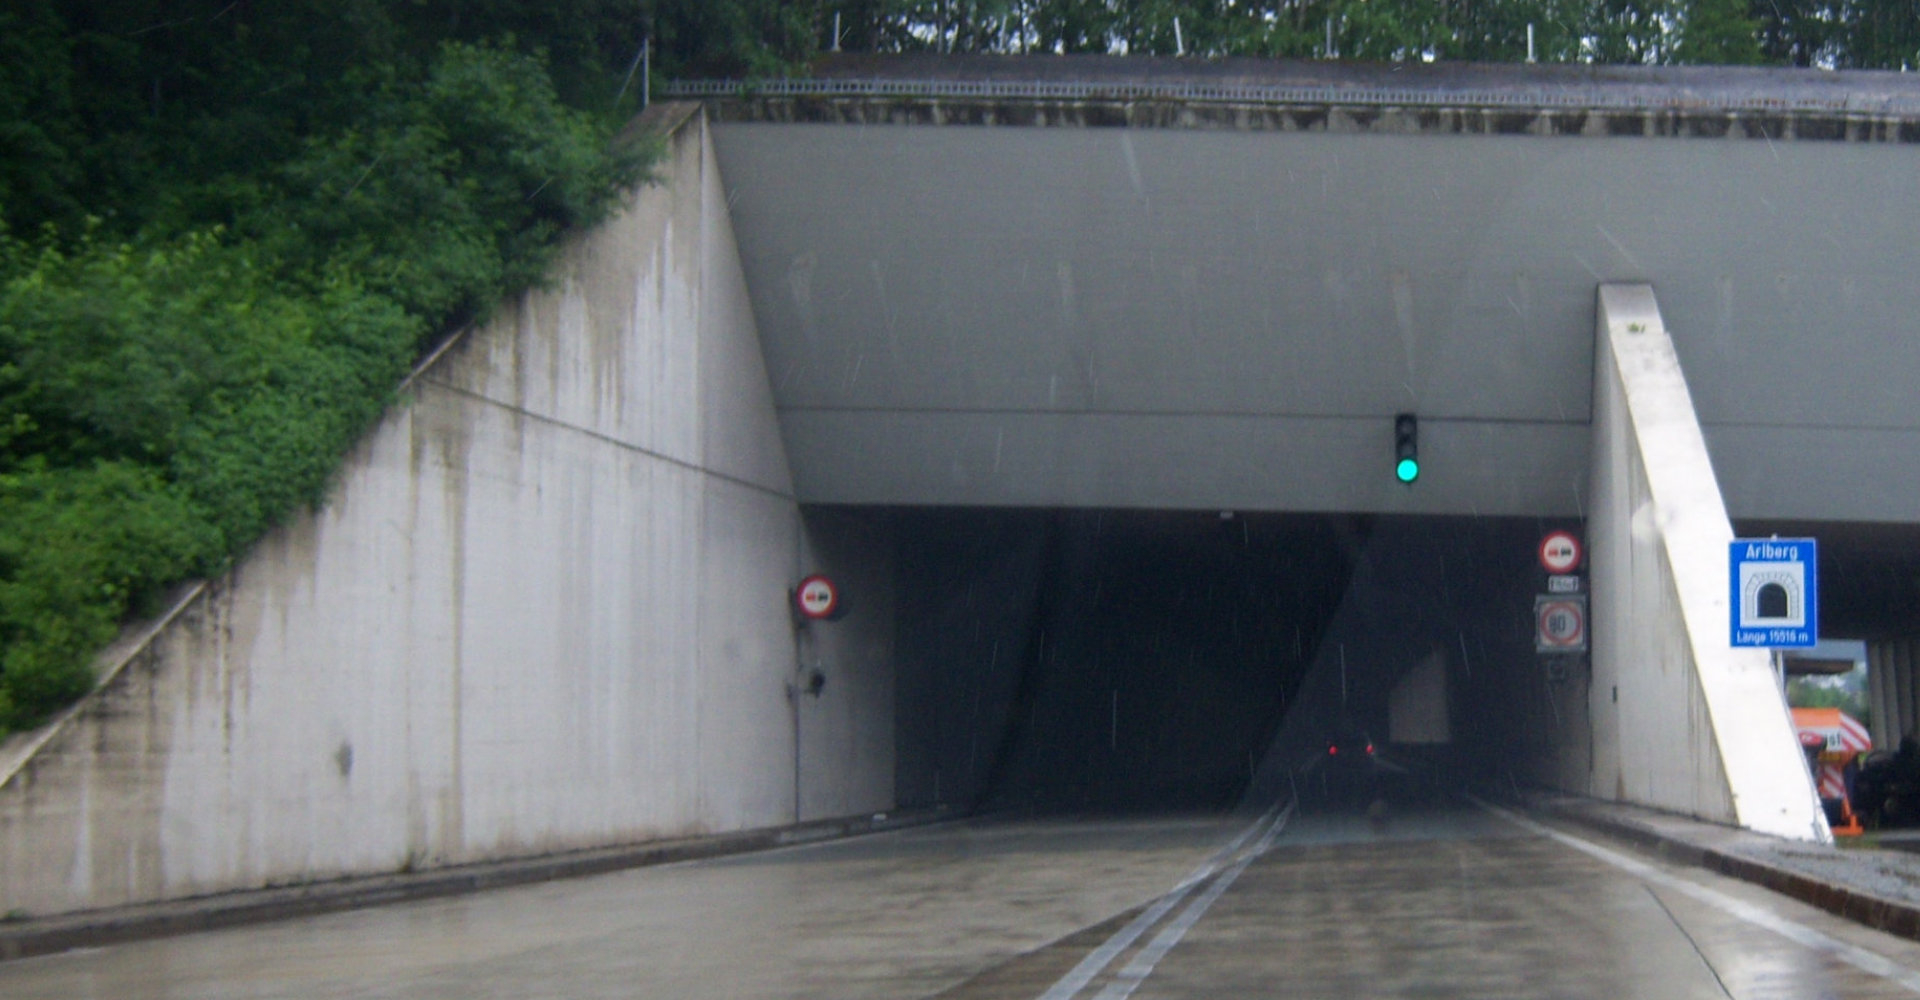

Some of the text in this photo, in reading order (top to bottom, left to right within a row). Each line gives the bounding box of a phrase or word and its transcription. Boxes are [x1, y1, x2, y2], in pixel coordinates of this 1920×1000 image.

[1746, 543, 1798, 561] Arlberg
[1736, 630, 1766, 644] Länge
[1798, 632, 1808, 643] m
